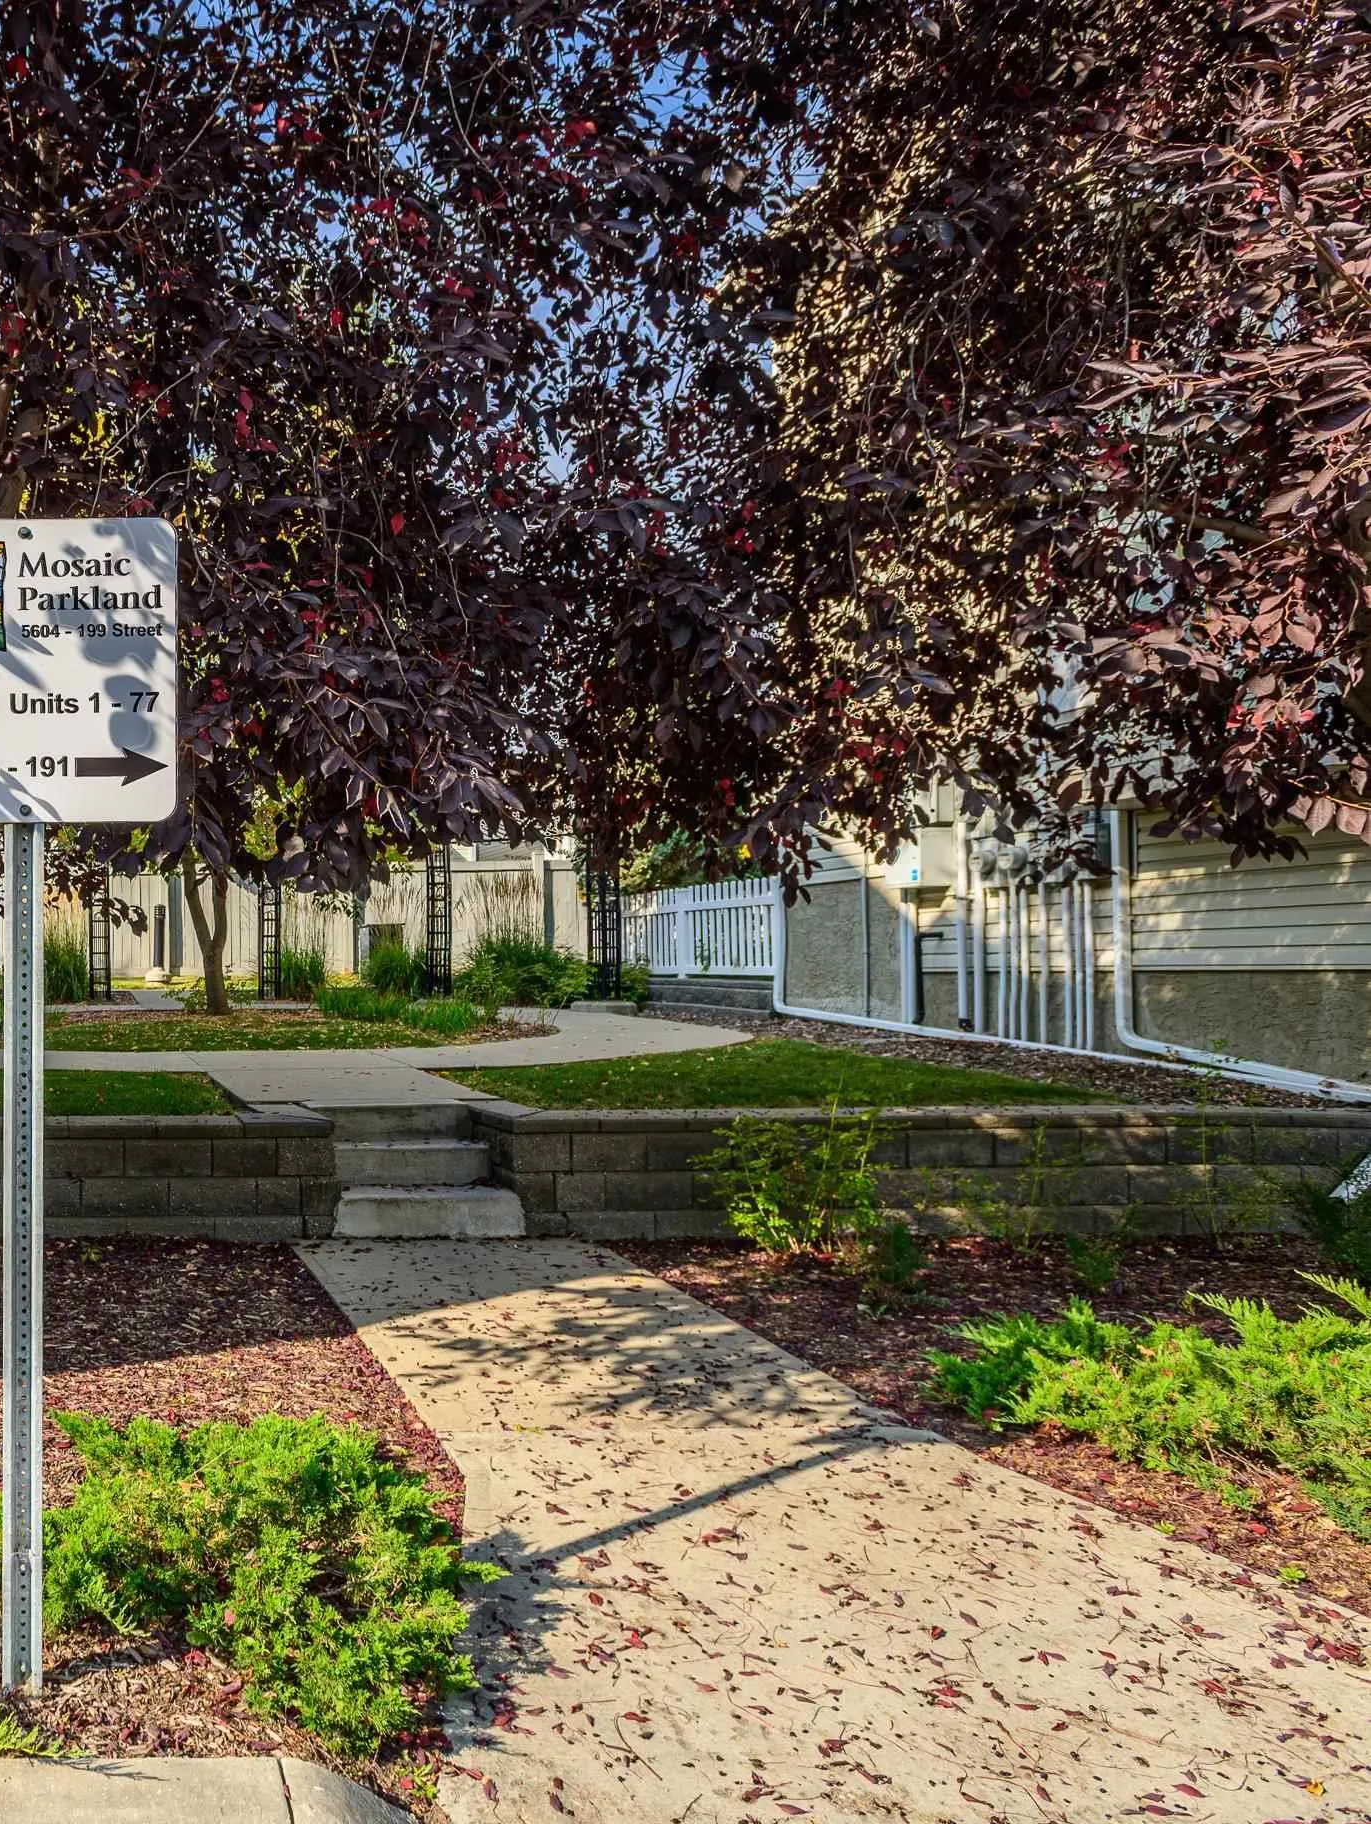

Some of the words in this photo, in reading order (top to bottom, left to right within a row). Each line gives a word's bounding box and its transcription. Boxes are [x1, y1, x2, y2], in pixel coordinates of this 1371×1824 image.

[18, 551, 132, 578] Mosaic
[18, 584, 164, 612] Parkland
[21, 624, 61, 638] 5604
[78, 623, 107, 638] 199
[112, 622, 163, 637] Street
[9, 692, 80, 714] Units
[89, 692, 101, 714] 1
[129, 691, 160, 713] 77
[25, 756, 69, 778] 191
